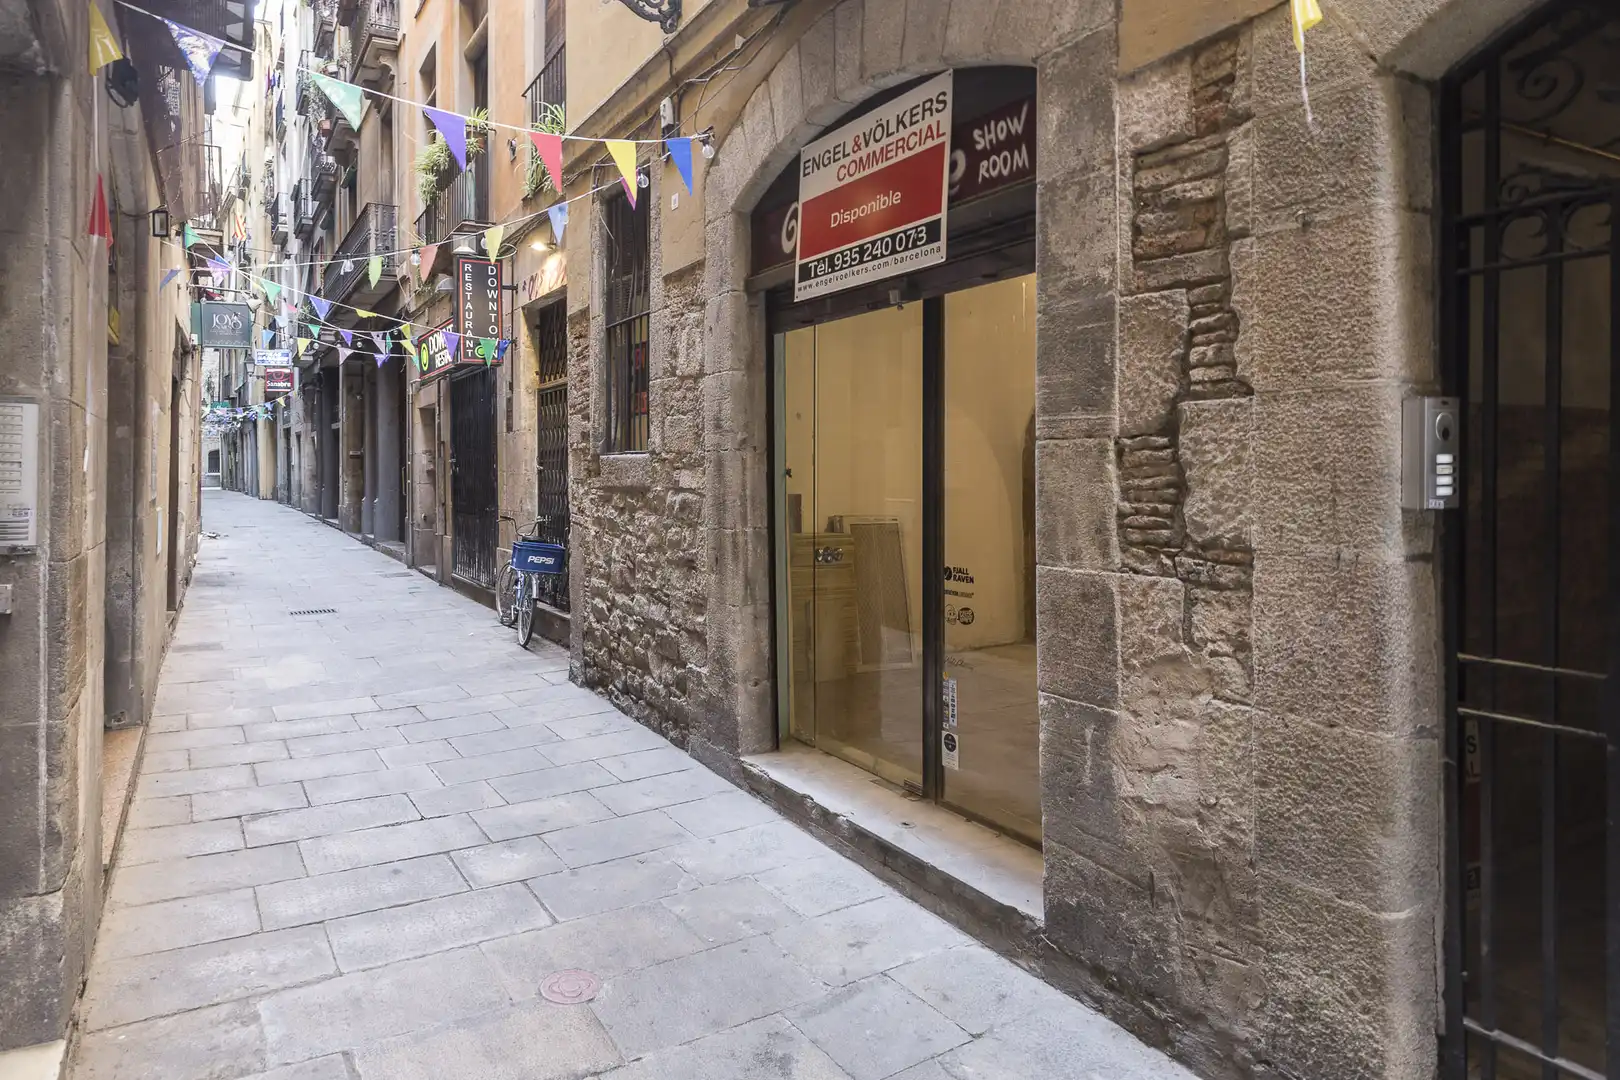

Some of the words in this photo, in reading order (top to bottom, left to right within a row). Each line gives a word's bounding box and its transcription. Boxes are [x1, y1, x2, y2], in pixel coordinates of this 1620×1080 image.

[972, 101, 1029, 151] SHOW
[836, 120, 946, 182] COMMERCIAL
[978, 143, 1029, 184] ROOM
[830, 190, 901, 228] Disponible
[834, 247, 860, 271] 935
[863, 240, 892, 263] 240
[895, 225, 927, 252] 073
[464, 263, 474, 357] RESTAURANT
[528, 555, 555, 564] PEPSI
[952, 575, 975, 584] RAVEN
